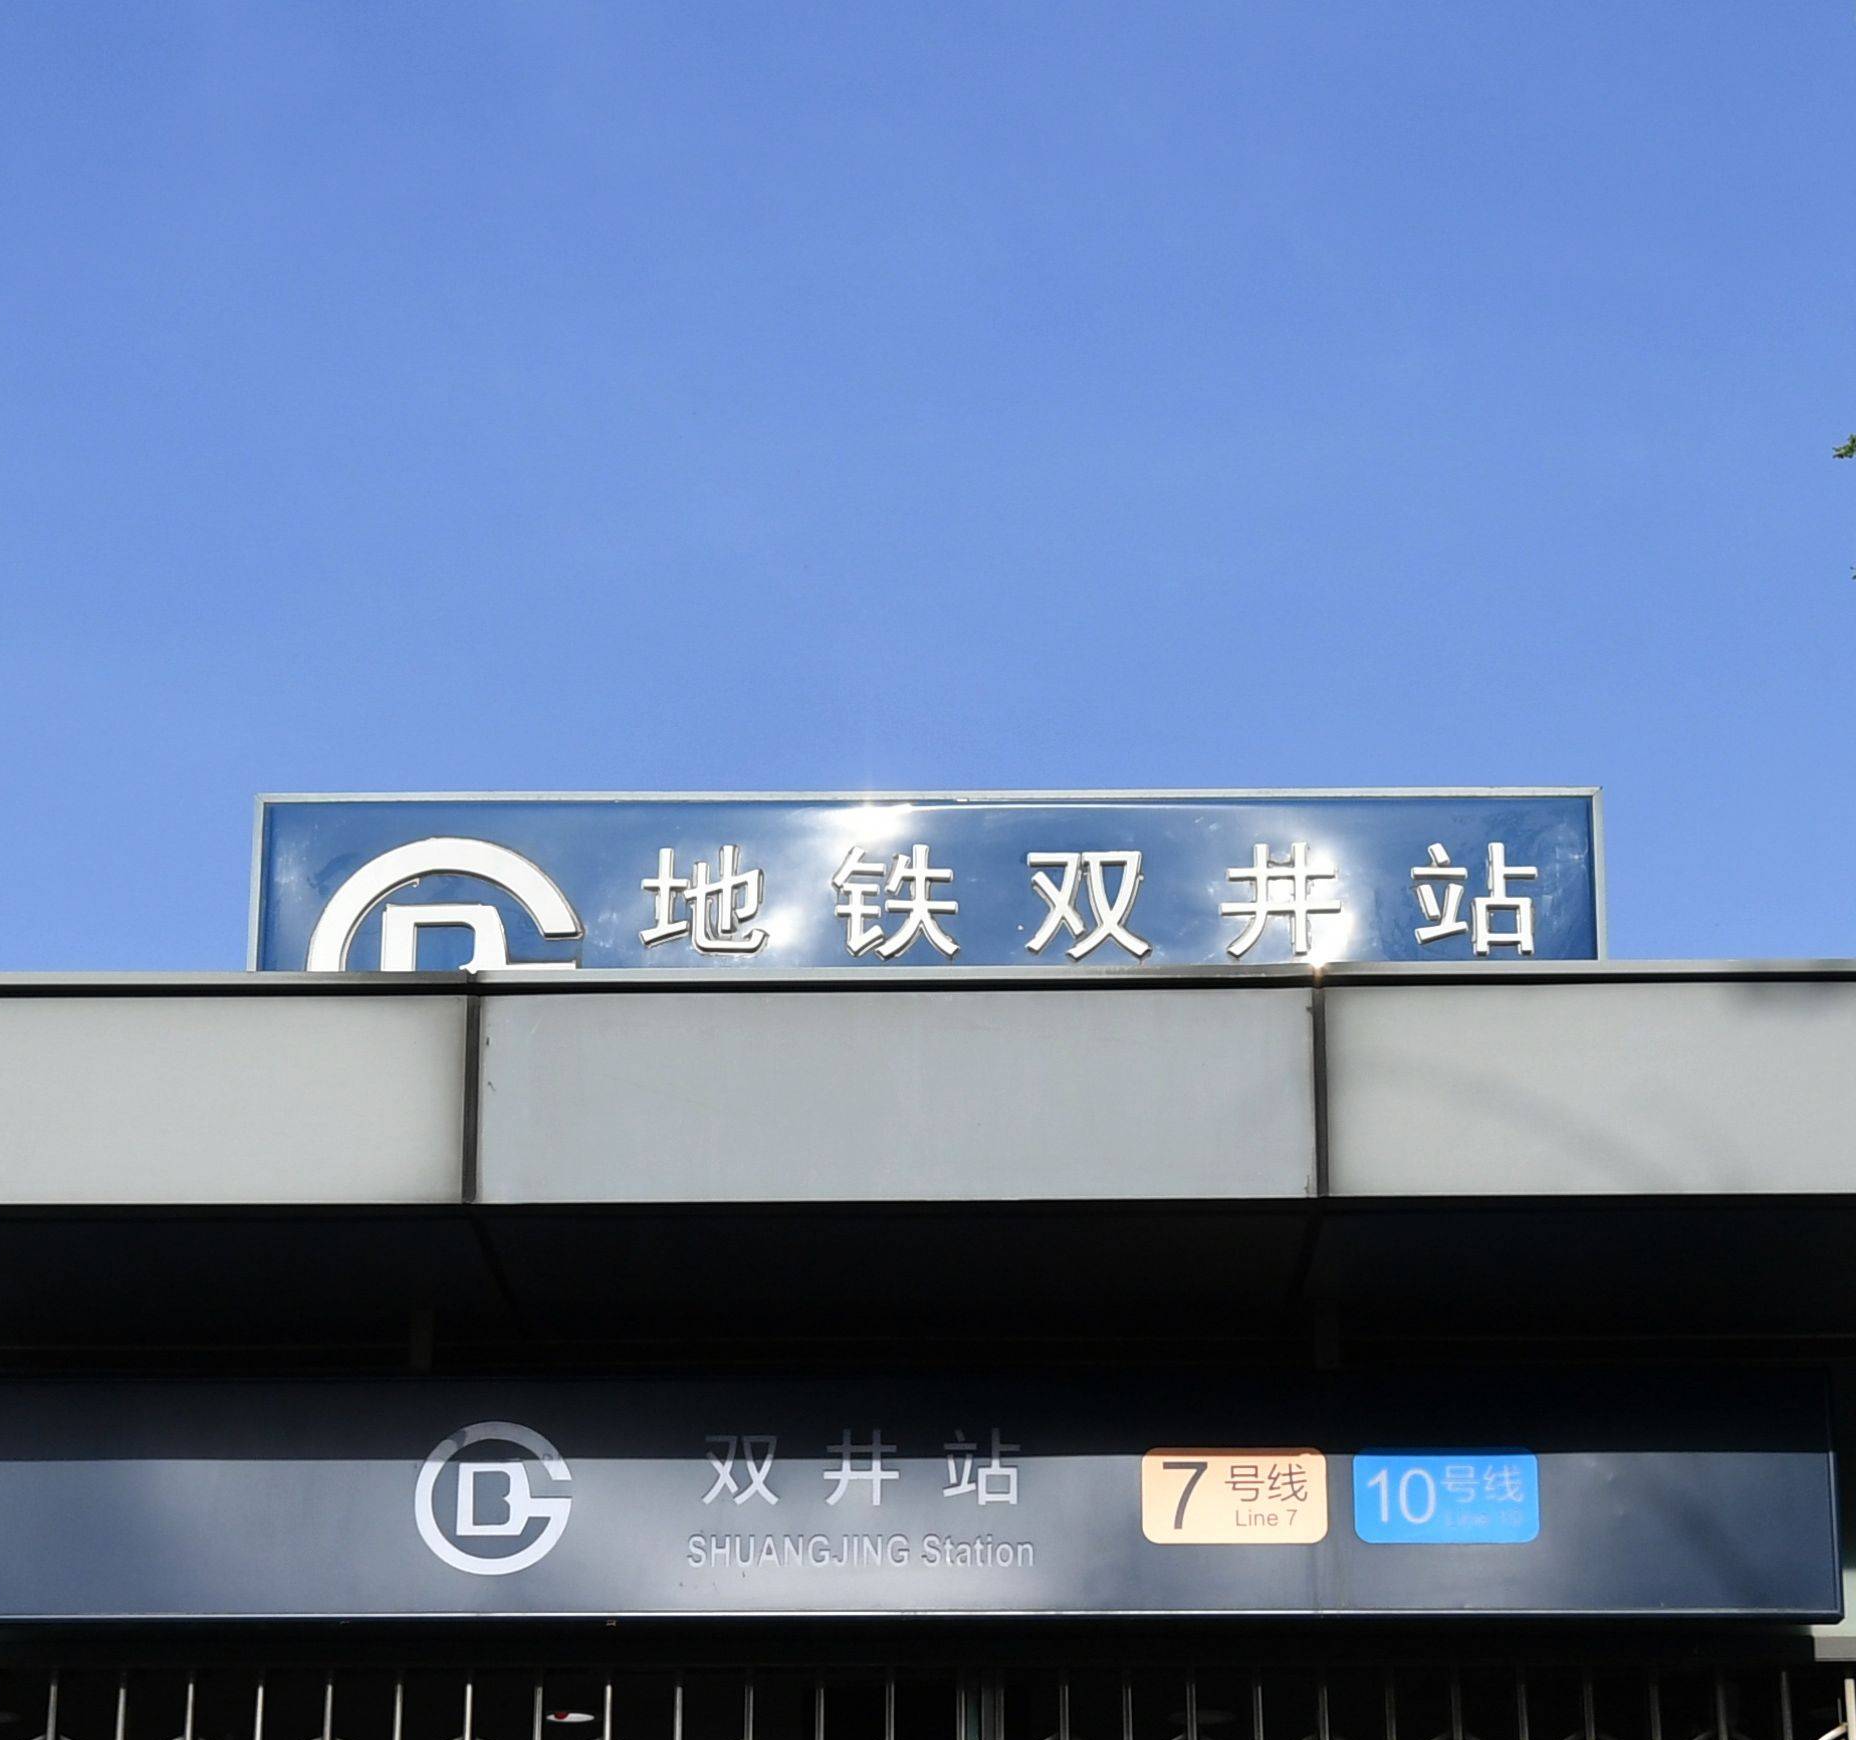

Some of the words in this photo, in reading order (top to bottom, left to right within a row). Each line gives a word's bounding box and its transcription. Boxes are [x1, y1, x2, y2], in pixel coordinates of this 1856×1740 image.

[639, 840, 1537, 960] 地铁双井站
[701, 1427, 1022, 1506] 双井站
[1234, 1508, 1278, 1528] Line
[1285, 1508, 1299, 1528] 7
[687, 1533, 911, 1568] SHUANGJING
[921, 1533, 1035, 1568] Station
